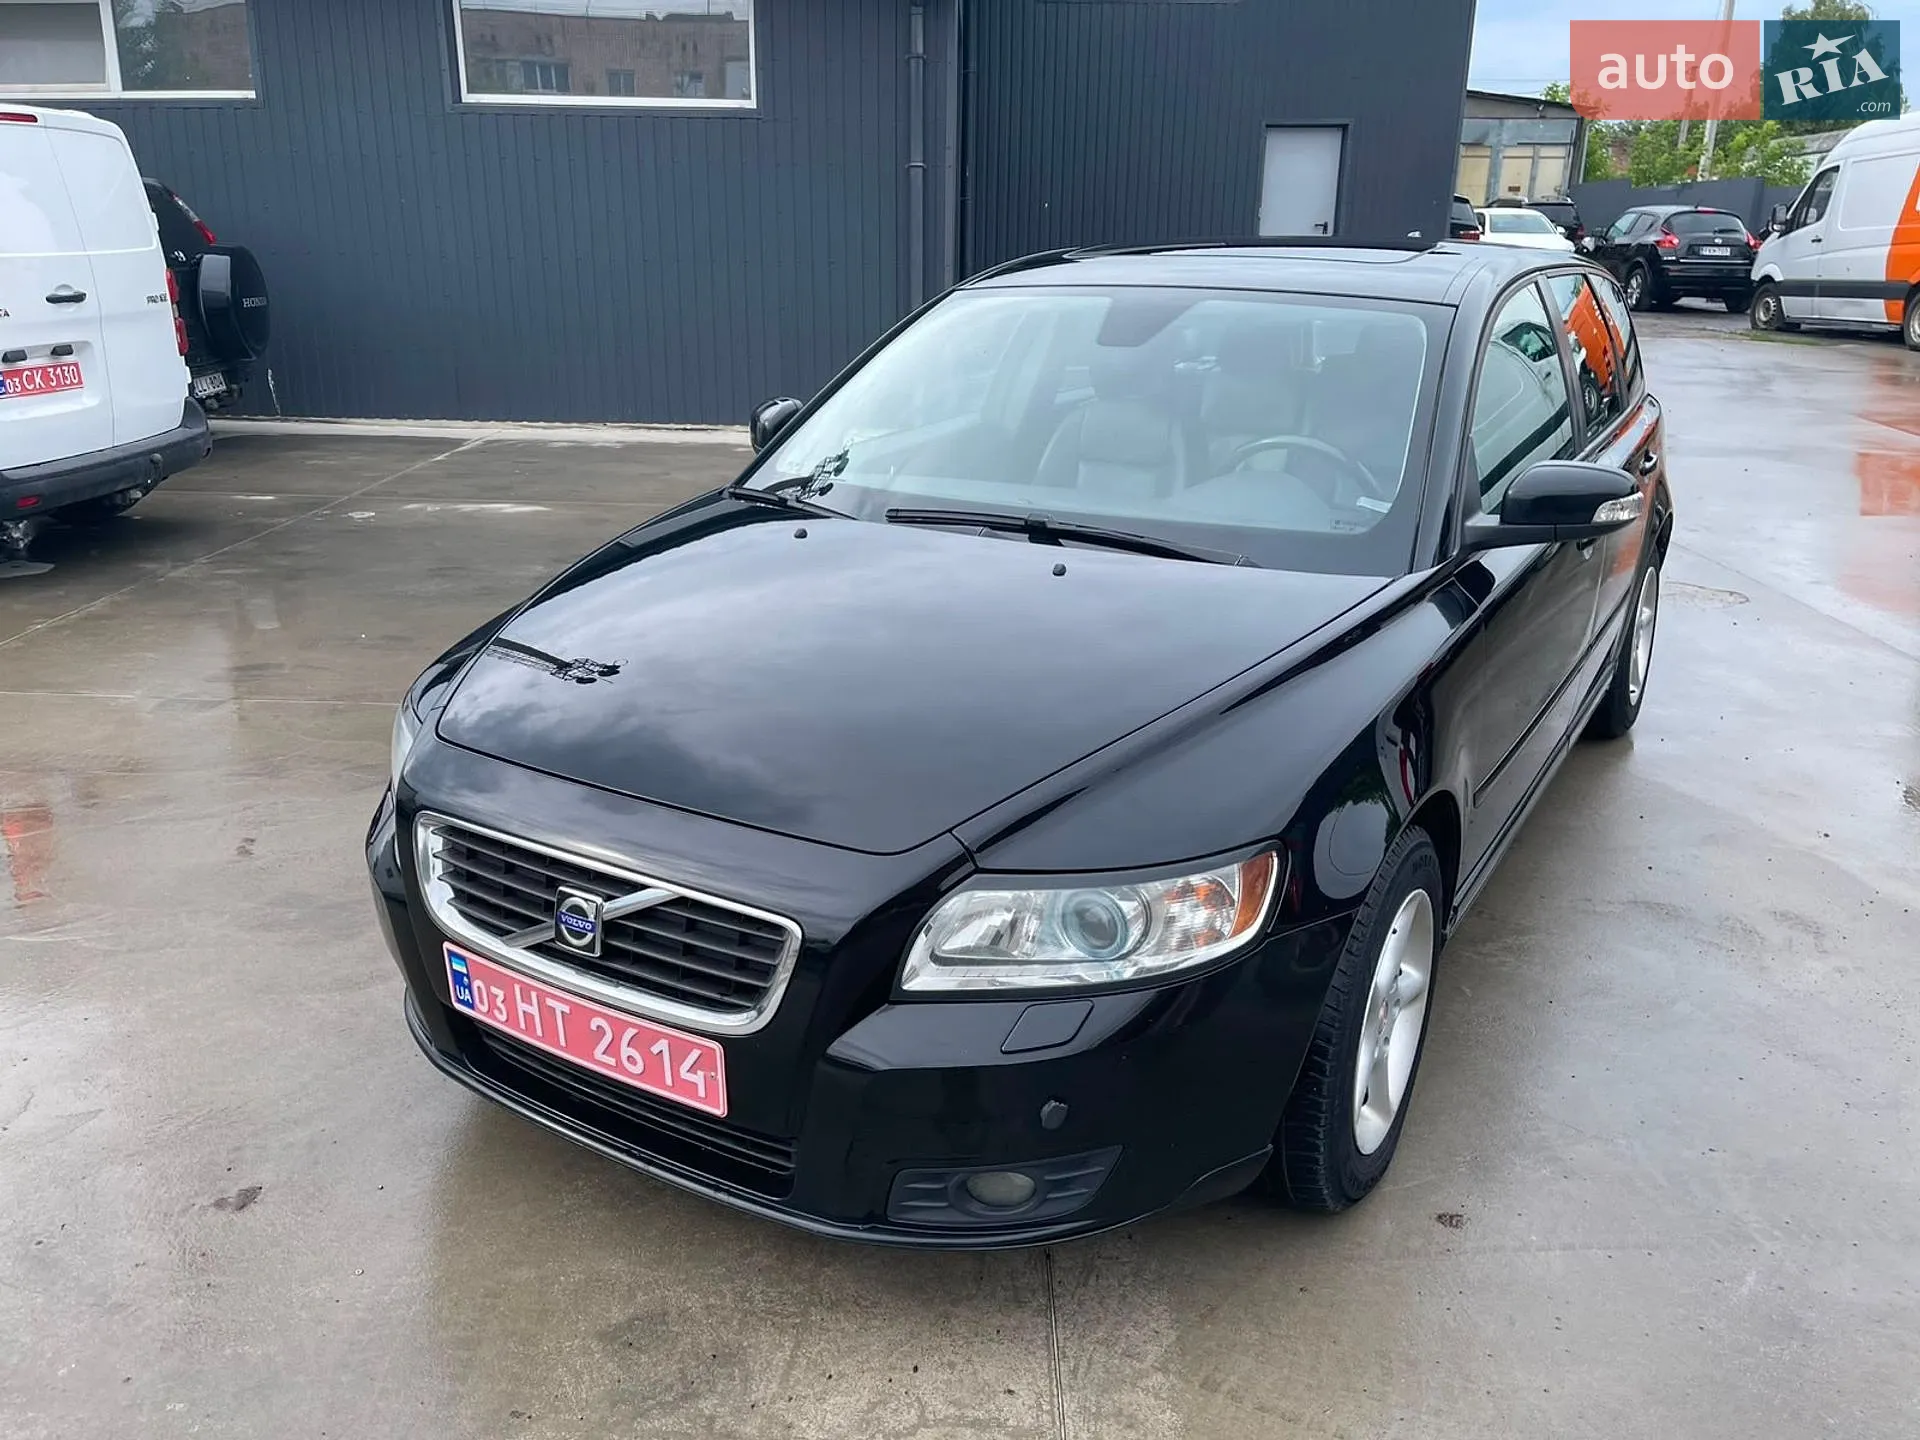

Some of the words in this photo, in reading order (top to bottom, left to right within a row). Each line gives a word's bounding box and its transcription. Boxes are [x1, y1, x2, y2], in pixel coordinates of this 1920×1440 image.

[6, 378, 22, 393] 03
[23, 370, 46, 390] CK
[47, 365, 79, 387] 3130
[561, 914, 592, 930] VOLVO
[456, 984, 473, 1004] UA
[472, 979, 508, 1023] 03
[513, 982, 571, 1048] HT
[590, 1016, 706, 1098] 2614
